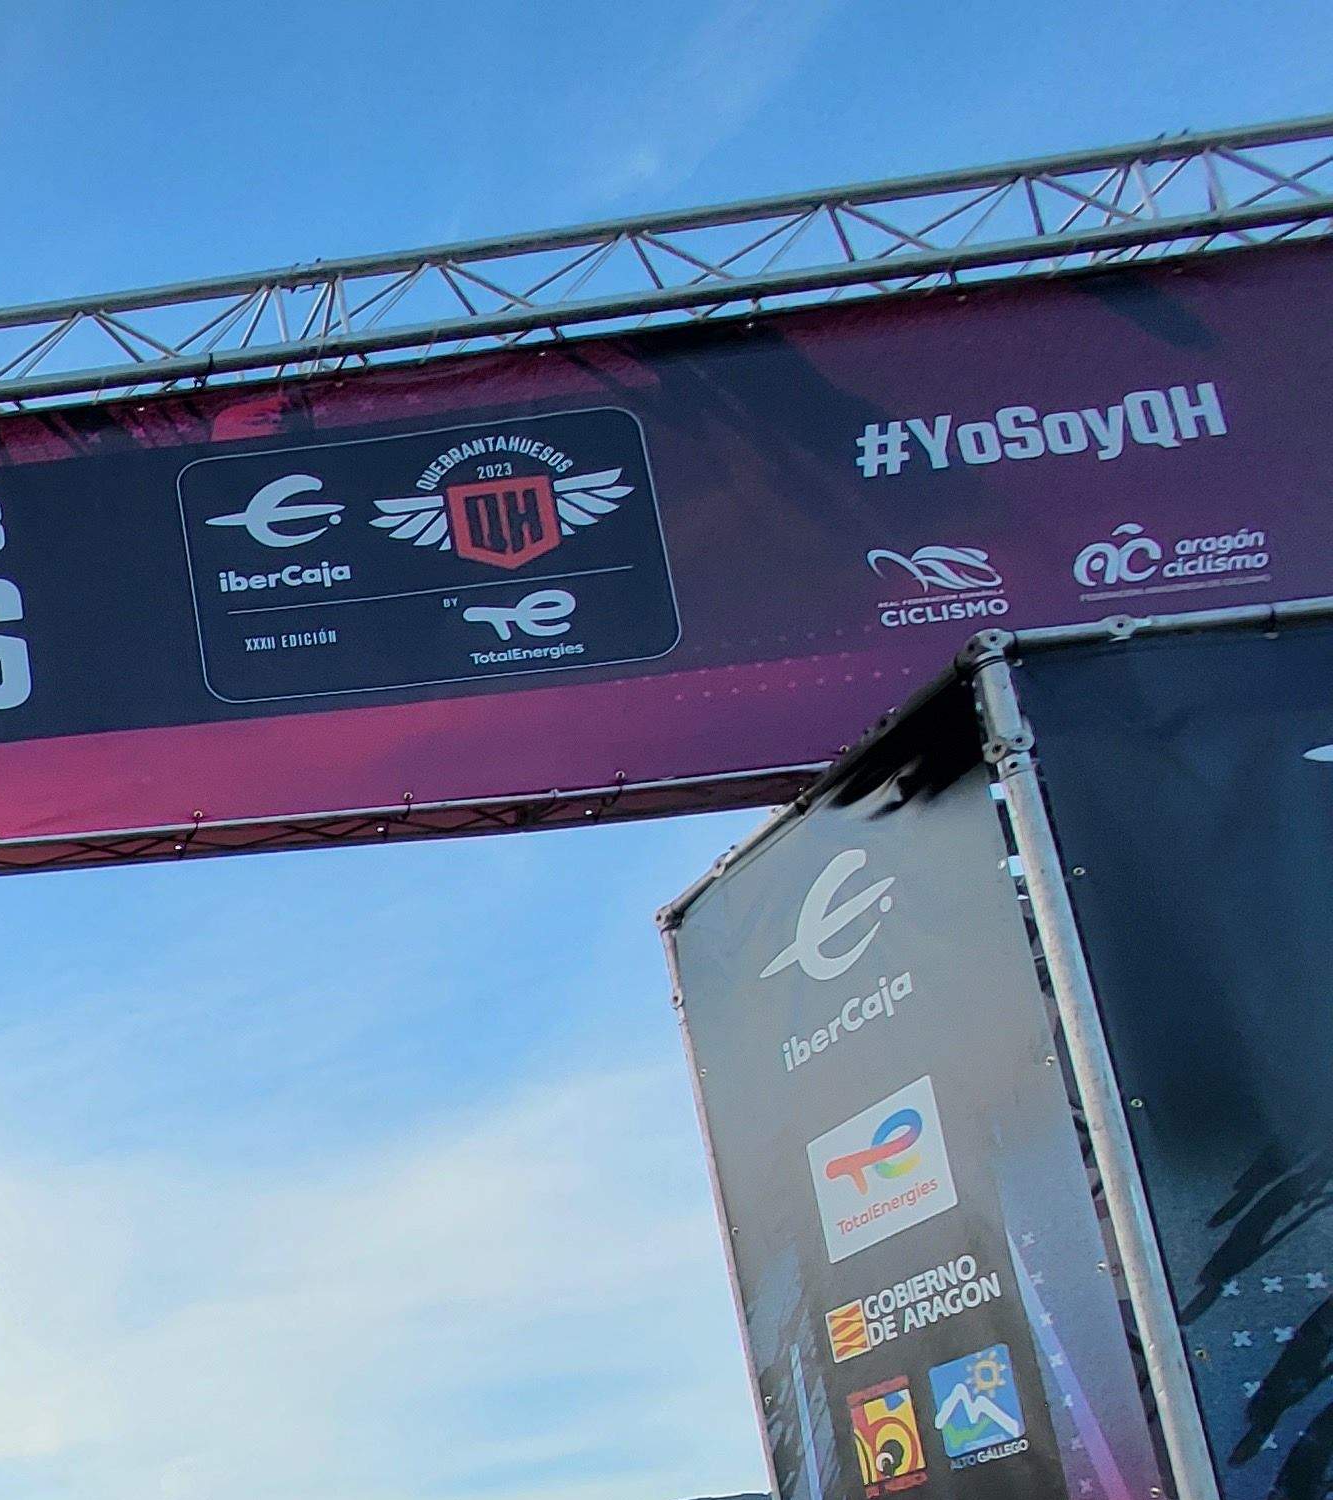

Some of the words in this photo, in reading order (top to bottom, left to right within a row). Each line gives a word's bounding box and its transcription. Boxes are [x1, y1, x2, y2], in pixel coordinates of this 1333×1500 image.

[855, 382, 1228, 478] #YoSoyQH
[416, 435, 575, 492] QUEBRANTAHUESOS
[476, 462, 513, 480] 2023
[1175, 528, 1265, 555] aragón
[219, 561, 352, 593] iberCaja
[1162, 552, 1269, 578] ciclismo
[443, 597, 458, 608] BY
[880, 598, 1009, 627] CICLISMO
[245, 636, 276, 651] XXXII
[281, 628, 337, 648] EDICIÓN
[470, 641, 585, 665] TotalEnergies
[782, 971, 913, 1073] iberCaja
[836, 1177, 939, 1236] TotalEnergies
[864, 1254, 978, 1320] GOBIERNO
[868, 1318, 898, 1347] DE
[903, 1272, 1002, 1333] ARAGON
